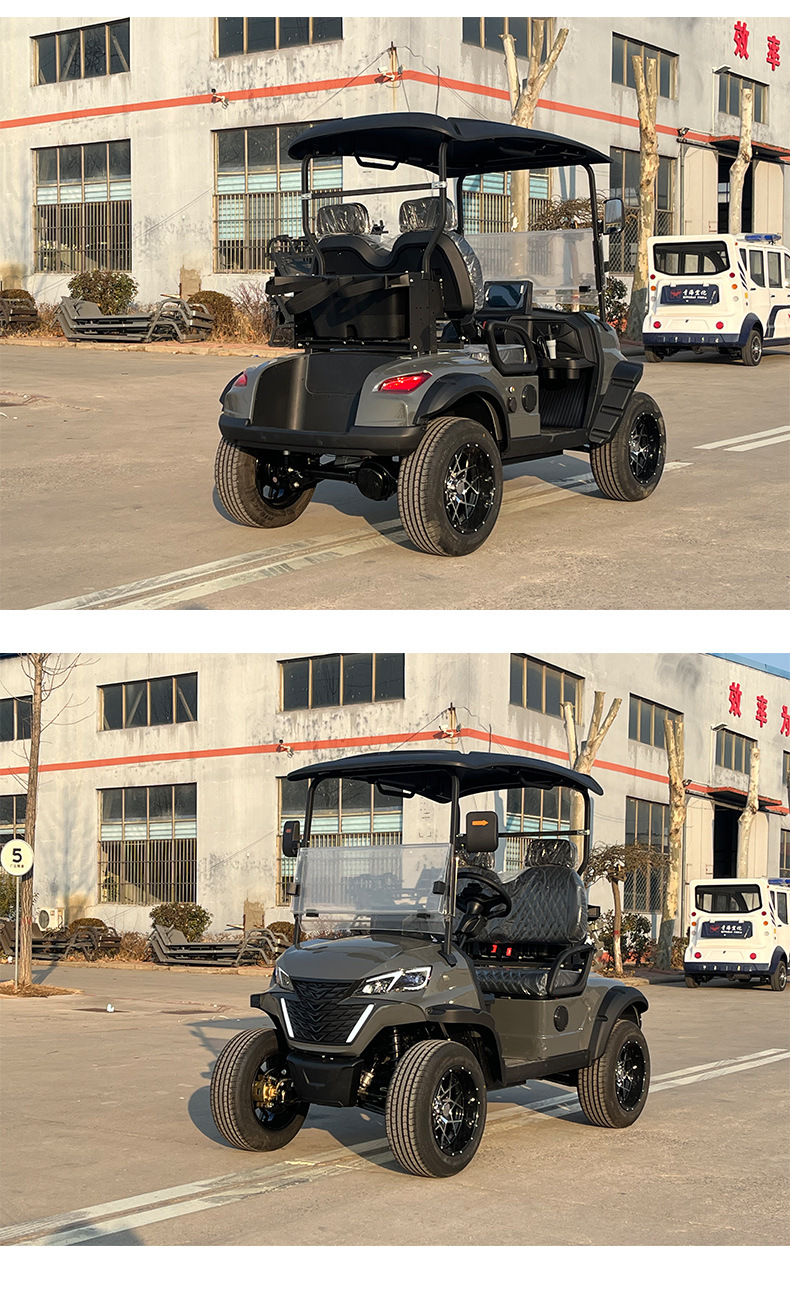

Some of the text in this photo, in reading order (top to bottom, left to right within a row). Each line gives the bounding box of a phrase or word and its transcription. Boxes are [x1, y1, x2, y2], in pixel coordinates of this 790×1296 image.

[733, 20, 780, 72] 效率
[728, 681, 790, 738] 效率为
[12, 848, 23, 863] 5
